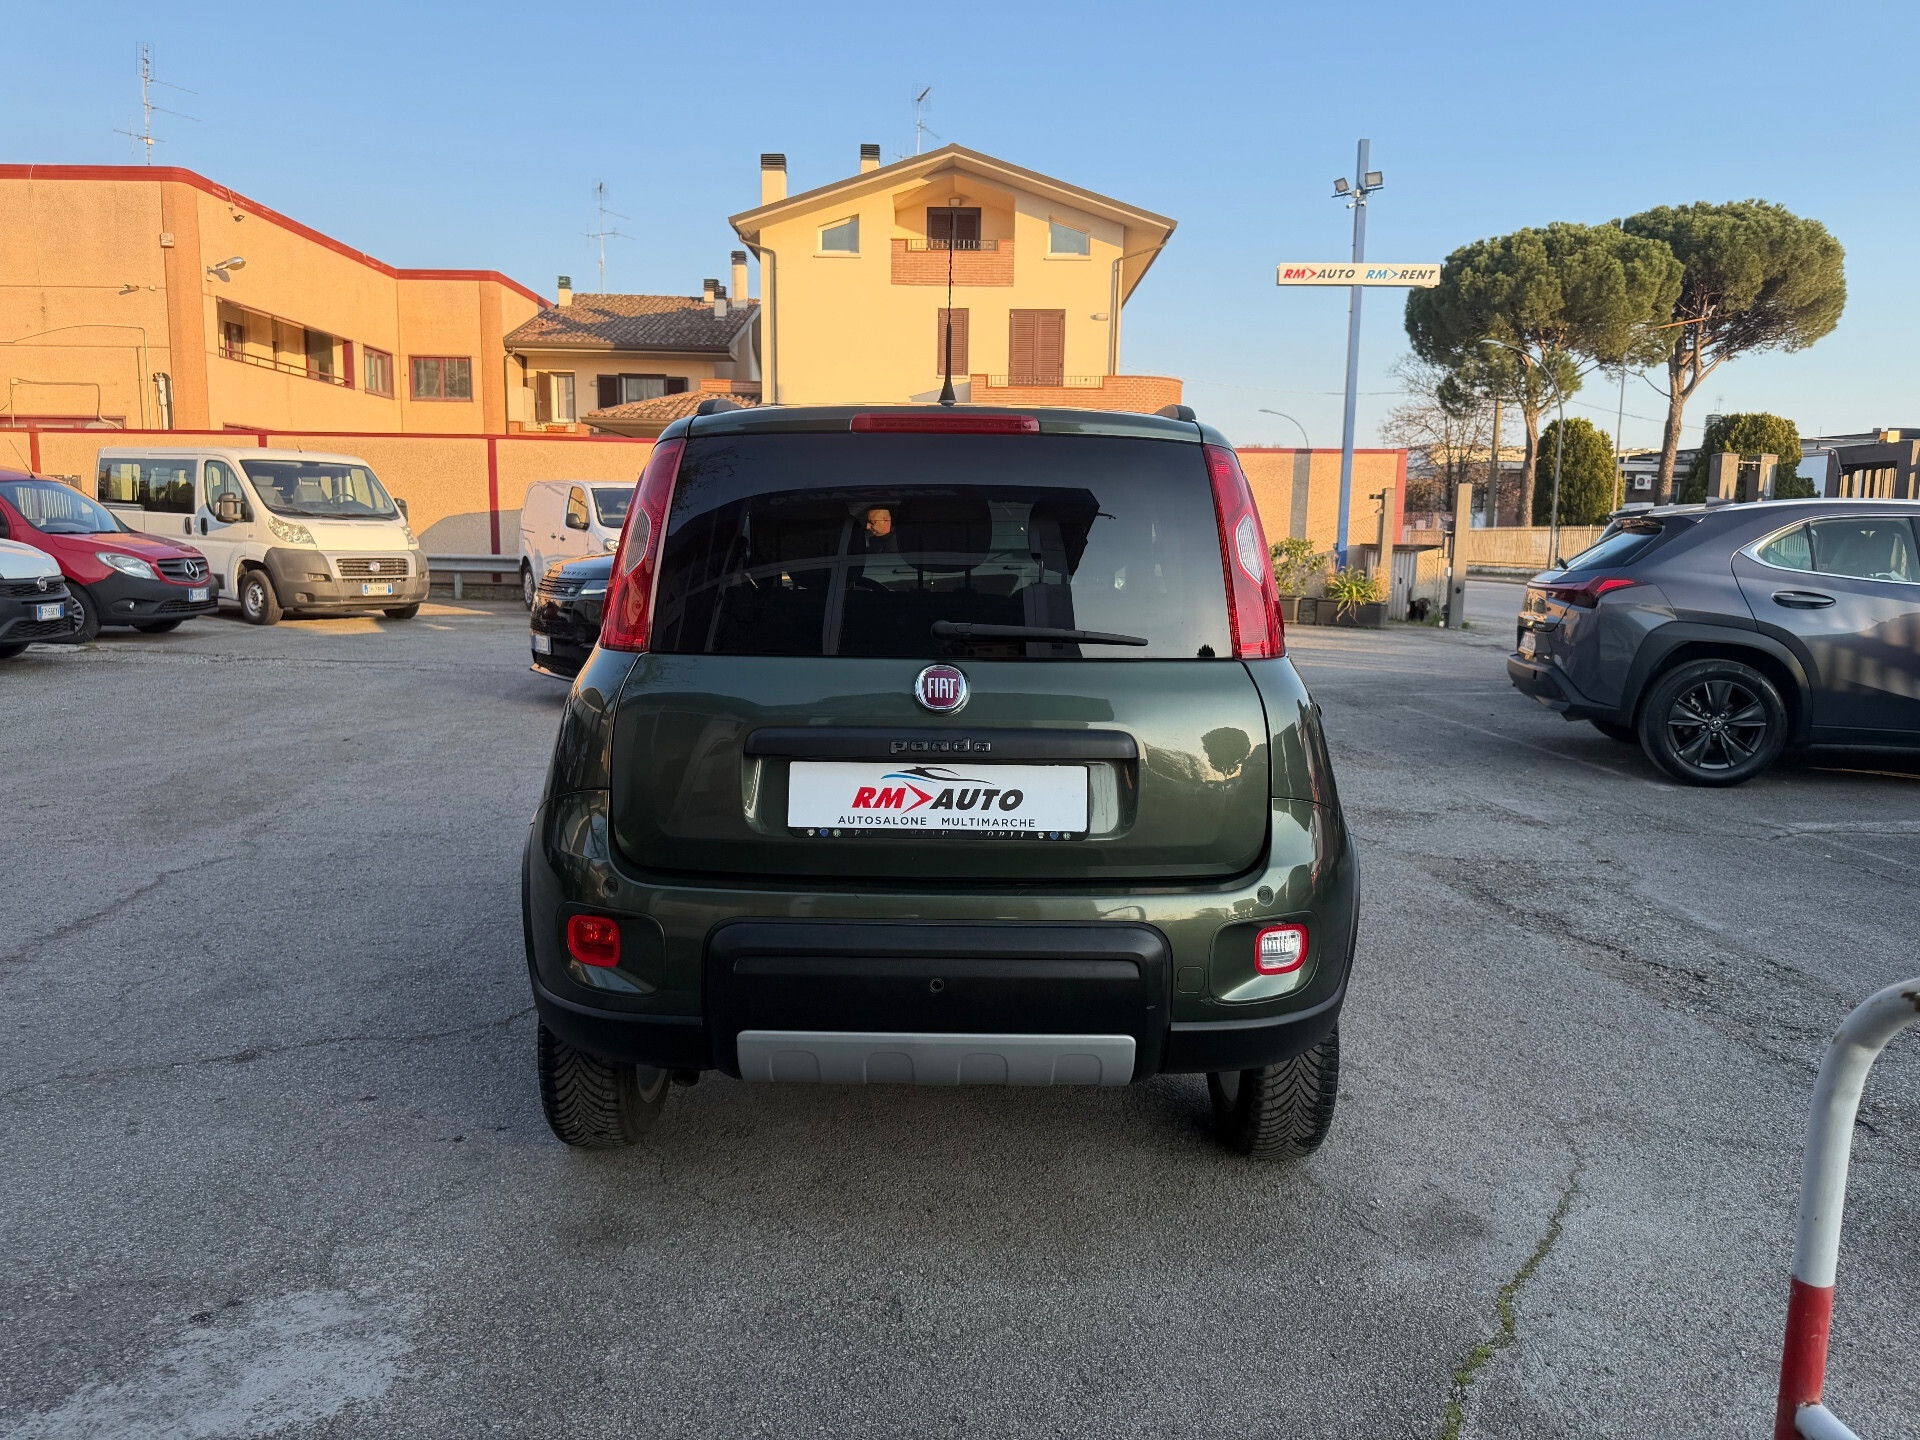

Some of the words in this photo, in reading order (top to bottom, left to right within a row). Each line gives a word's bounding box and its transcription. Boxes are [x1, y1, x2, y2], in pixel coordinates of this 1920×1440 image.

[927, 677, 957, 699] FIAT
[889, 737, 992, 755] panda
[929, 788, 1024, 812] AUTO
[837, 815, 927, 826] AUTOSALONE
[941, 817, 1036, 828] MULTIMARCHE
